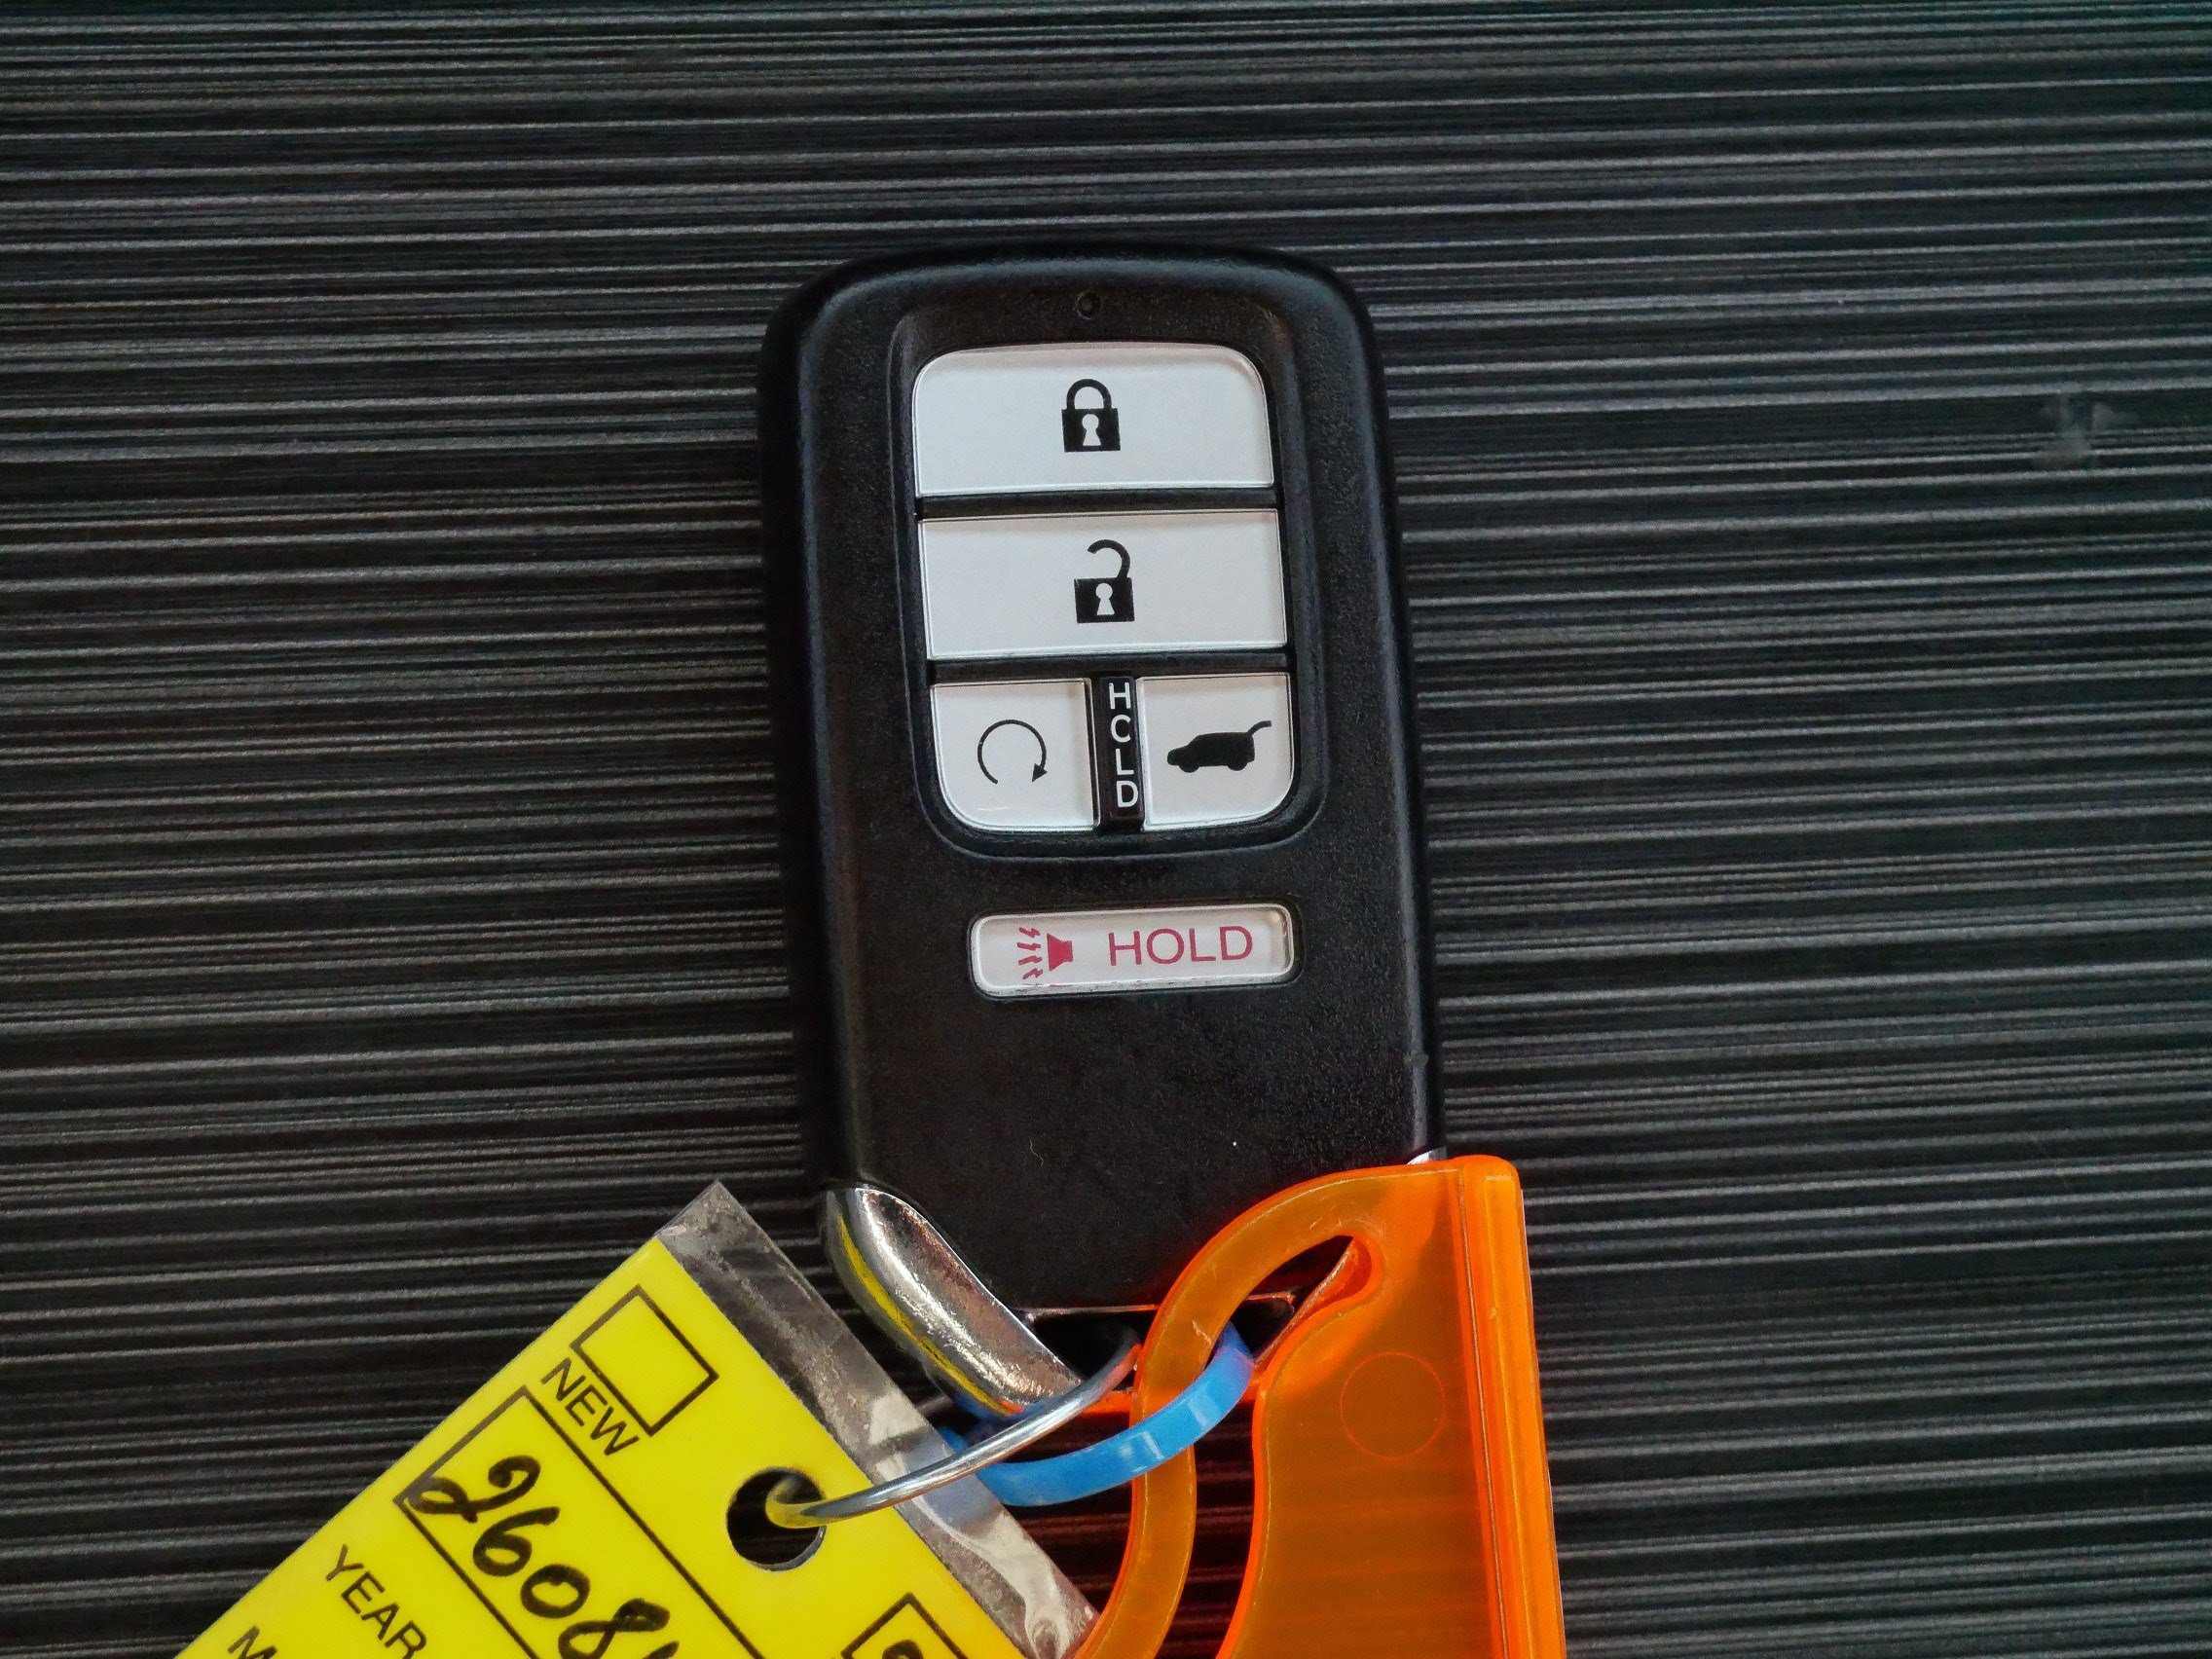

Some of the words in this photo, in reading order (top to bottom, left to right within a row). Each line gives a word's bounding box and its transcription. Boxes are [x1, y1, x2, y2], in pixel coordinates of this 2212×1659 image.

[1109, 926, 1253, 967] HOLD
[540, 1357, 641, 1456] NEW
[325, 1544, 427, 1659] YEAR
[402, 1456, 680, 1659] 2608
